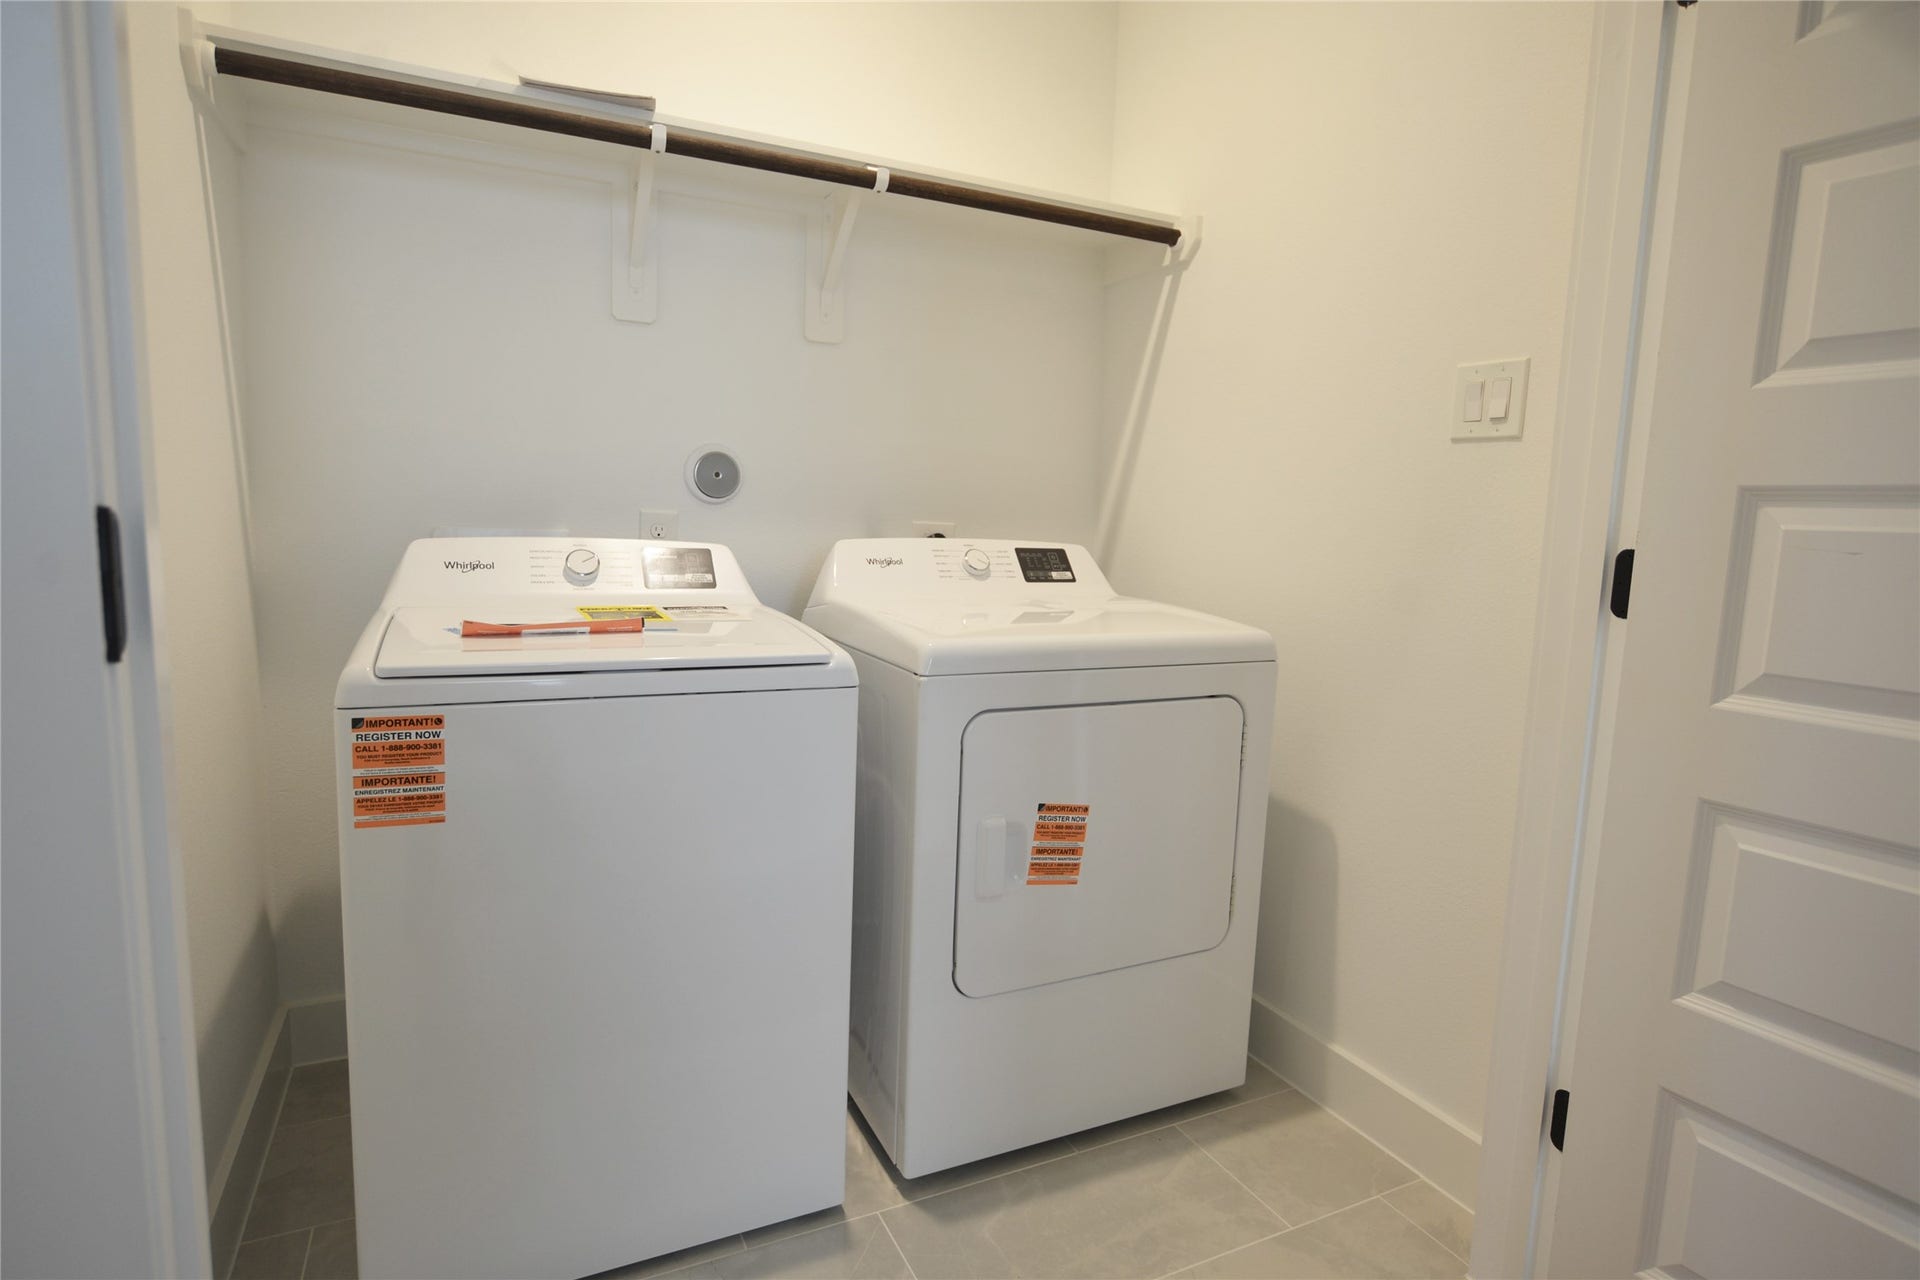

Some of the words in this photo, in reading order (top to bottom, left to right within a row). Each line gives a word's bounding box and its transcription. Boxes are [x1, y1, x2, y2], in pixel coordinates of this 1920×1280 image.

[443, 560, 495, 573] Whirlpool
[866, 556, 903, 568] Whirlpool
[366, 718, 433, 728] IMPORTANT!
[356, 732, 412, 742] REGISTER
[415, 731, 441, 740] NOW
[355, 745, 378, 753] CALL
[382, 743, 442, 752] 1-888-900-3381
[361, 776, 436, 786] IMPORTANTE!
[355, 788, 401, 796] ENREGISTREZ
